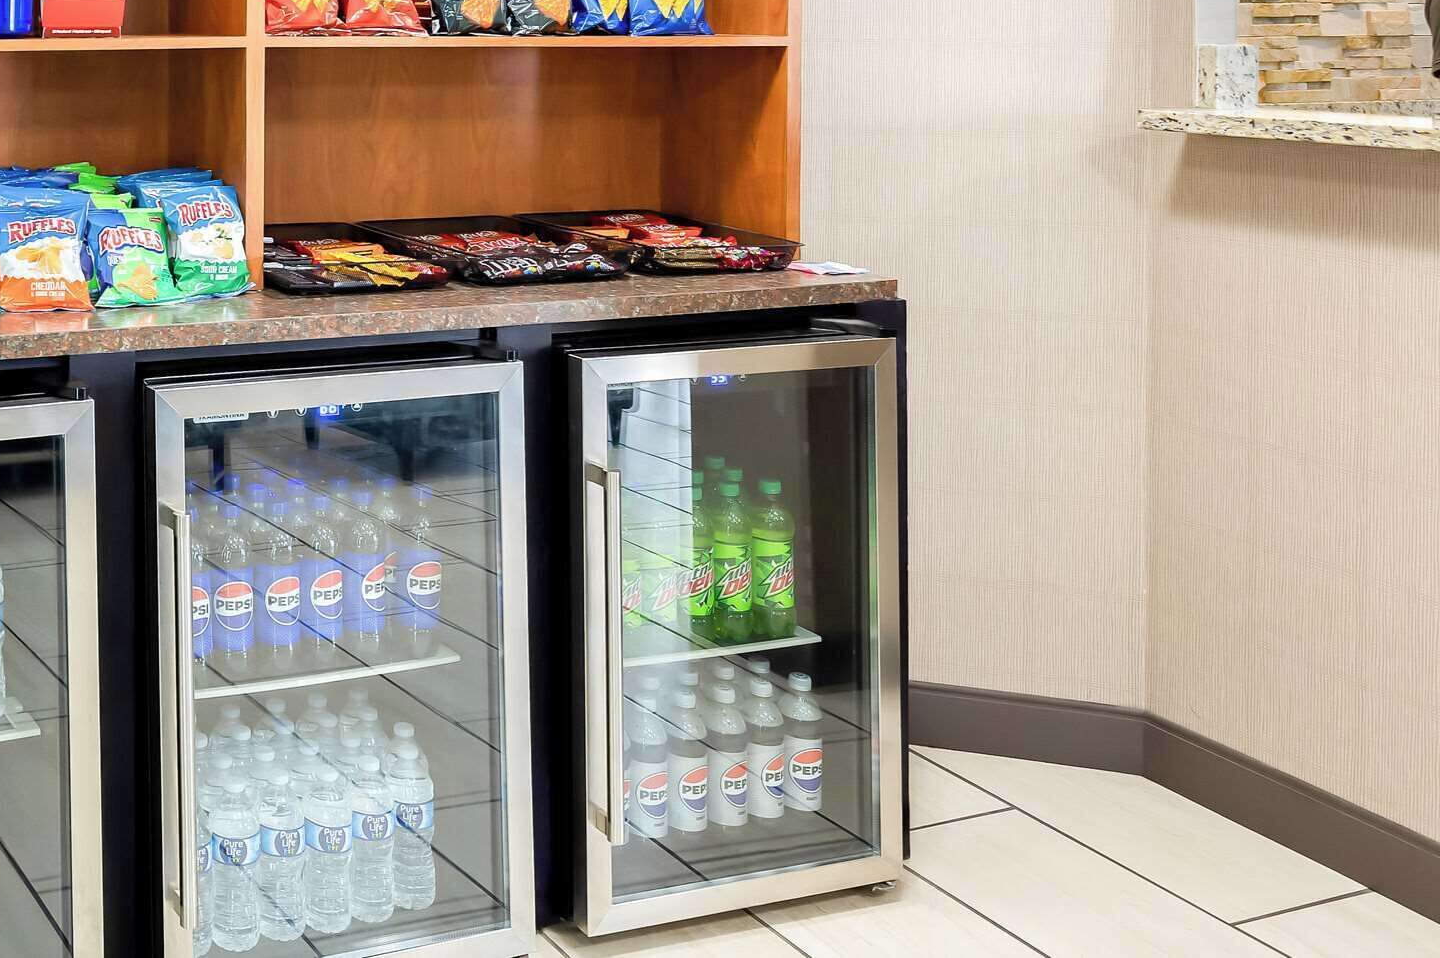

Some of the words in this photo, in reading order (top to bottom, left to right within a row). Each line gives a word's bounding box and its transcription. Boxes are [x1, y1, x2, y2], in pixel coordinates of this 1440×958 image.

[176, 201, 234, 226] RUFFLES
[7, 217, 77, 244] RUFFLES
[98, 227, 164, 255] RUFFLES
[218, 265, 237, 274] CREAM
[30, 281, 67, 291] CHEDDAR
[364, 581, 384, 594] PEP
[409, 578, 441, 590] PEPS
[268, 593, 300, 606] PEPS
[313, 587, 342, 601] PEPS
[193, 604, 209, 617] PSI
[792, 764, 823, 776] PEPS
[682, 784, 707, 795] PEP
[724, 779, 747, 790] PEP
[640, 790, 668, 801] PEP
[400, 804, 419, 815] Pure
[366, 814, 386, 826] Pure
[402, 812, 417, 822] Life
[324, 827, 343, 838] Pure
[369, 823, 384, 833] Life
[280, 830, 298, 841] Pure
[325, 835, 341, 845] Life
[224, 838, 244, 849] Pure
[281, 838, 296, 849] Life
[225, 846, 242, 858] Life
